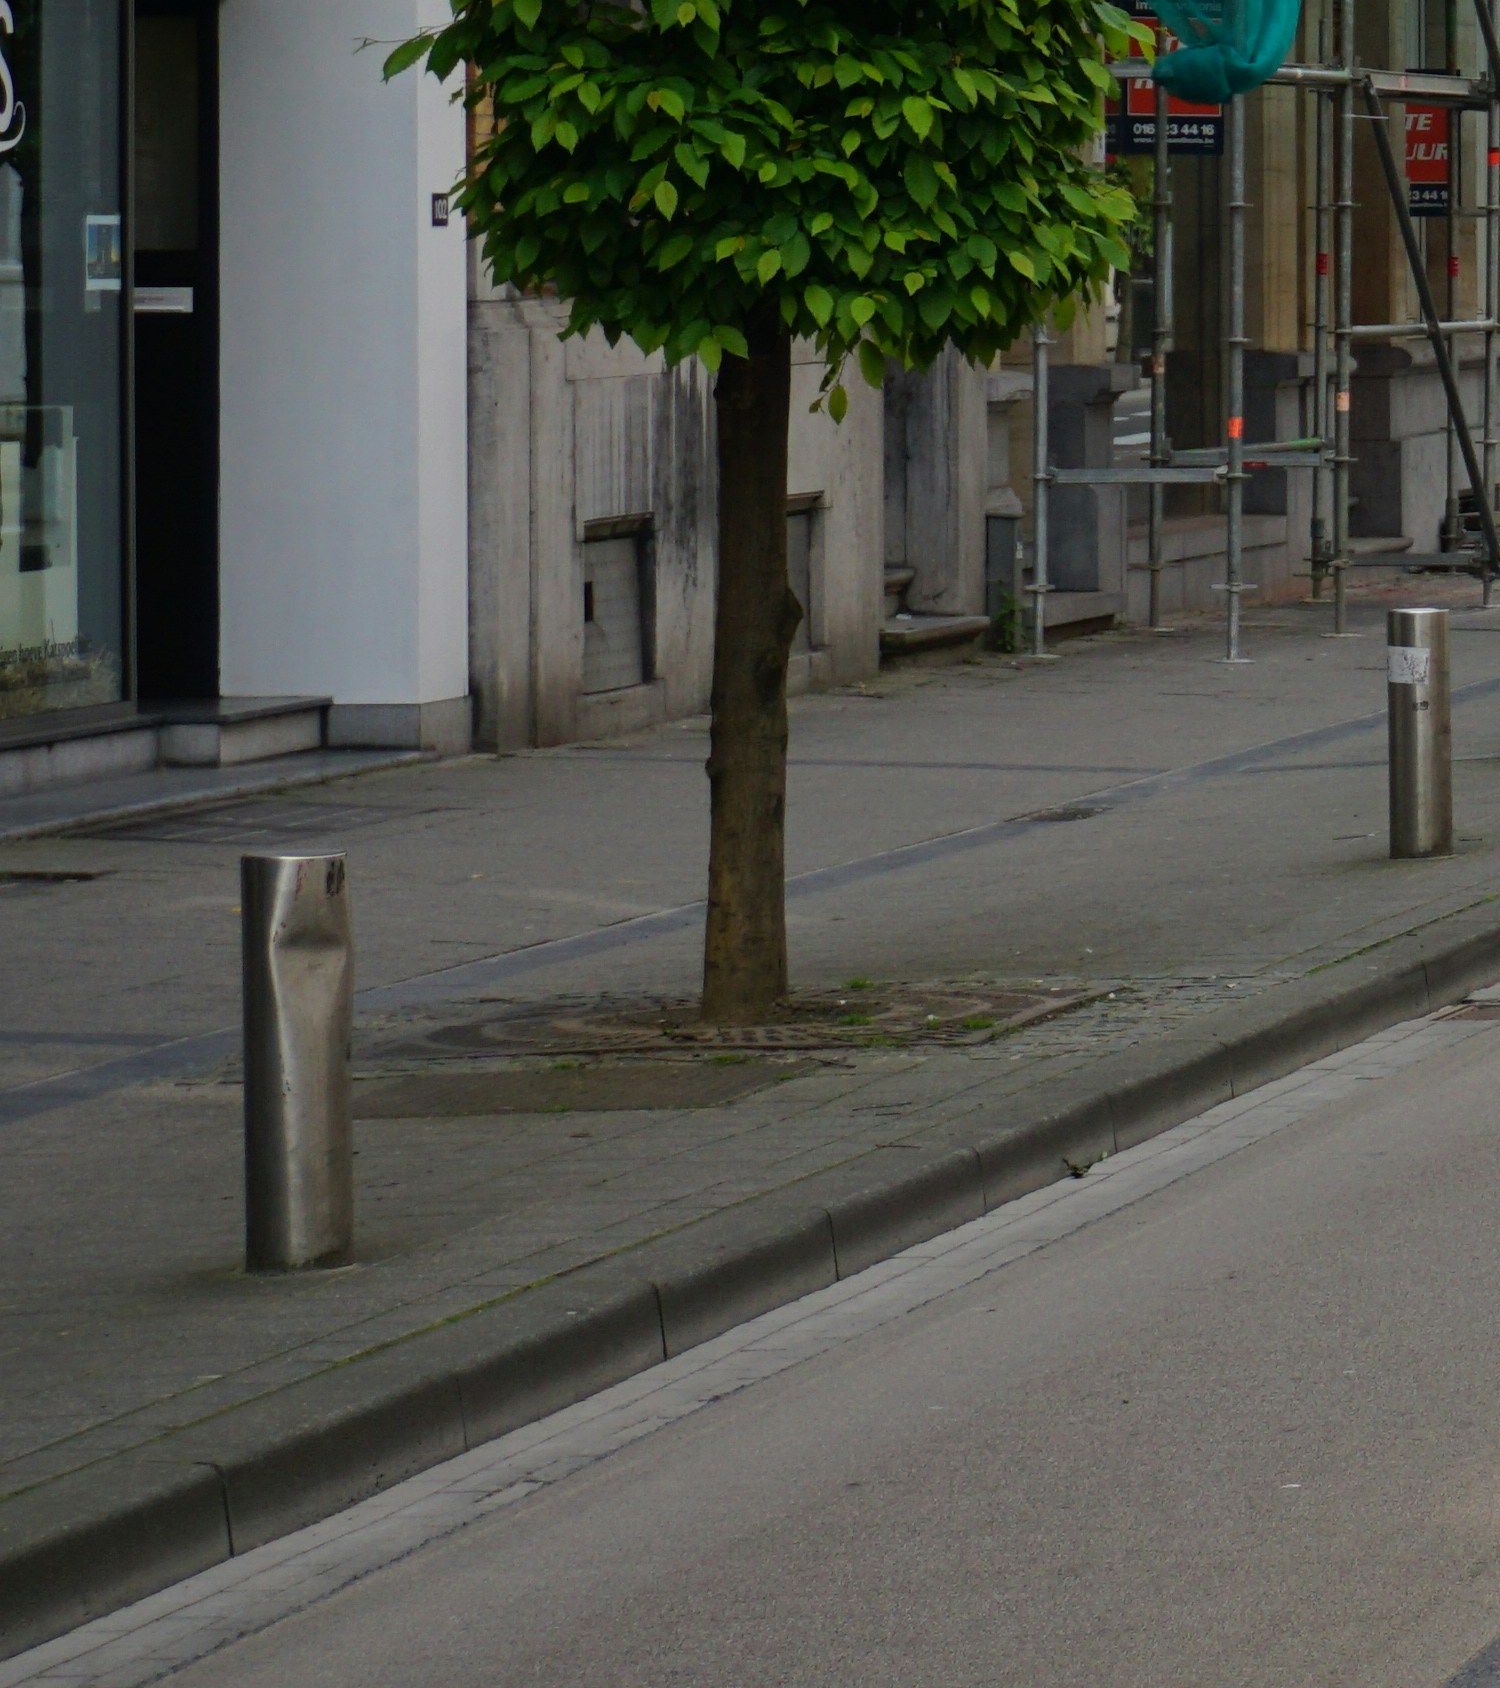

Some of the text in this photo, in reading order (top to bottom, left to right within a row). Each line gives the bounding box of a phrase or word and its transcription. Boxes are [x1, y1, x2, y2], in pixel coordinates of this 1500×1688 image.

[1180, 123, 1199, 136] 44
[1404, 143, 1449, 161] UUR
[1421, 190, 1439, 201] 44
[434, 198, 448, 220] 102
